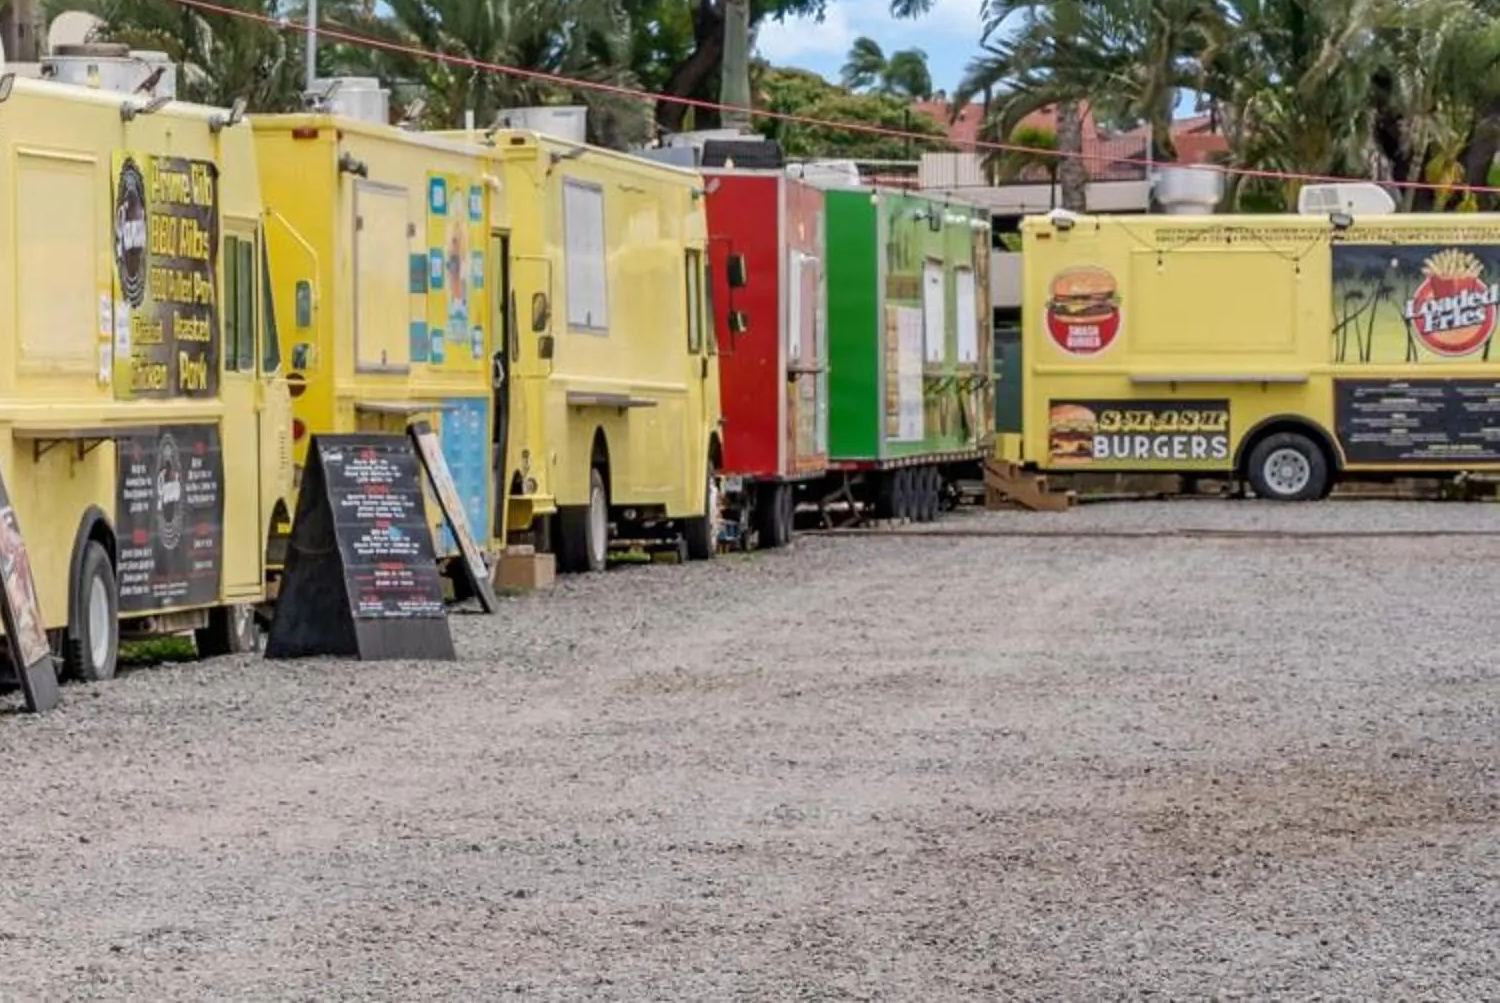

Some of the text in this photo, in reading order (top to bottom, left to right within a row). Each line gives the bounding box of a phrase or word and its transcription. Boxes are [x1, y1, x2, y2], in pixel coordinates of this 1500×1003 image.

[151, 158, 213, 207] Prime Rib
[151, 214, 179, 257] BBQ
[180, 217, 210, 260] Ribs
[1405, 284, 1499, 318] Loaded
[1423, 308, 1486, 333] Fries
[179, 349, 208, 391] Pork
[1099, 409, 1230, 433] SMASH
[1092, 435, 1229, 459] BURGERS
